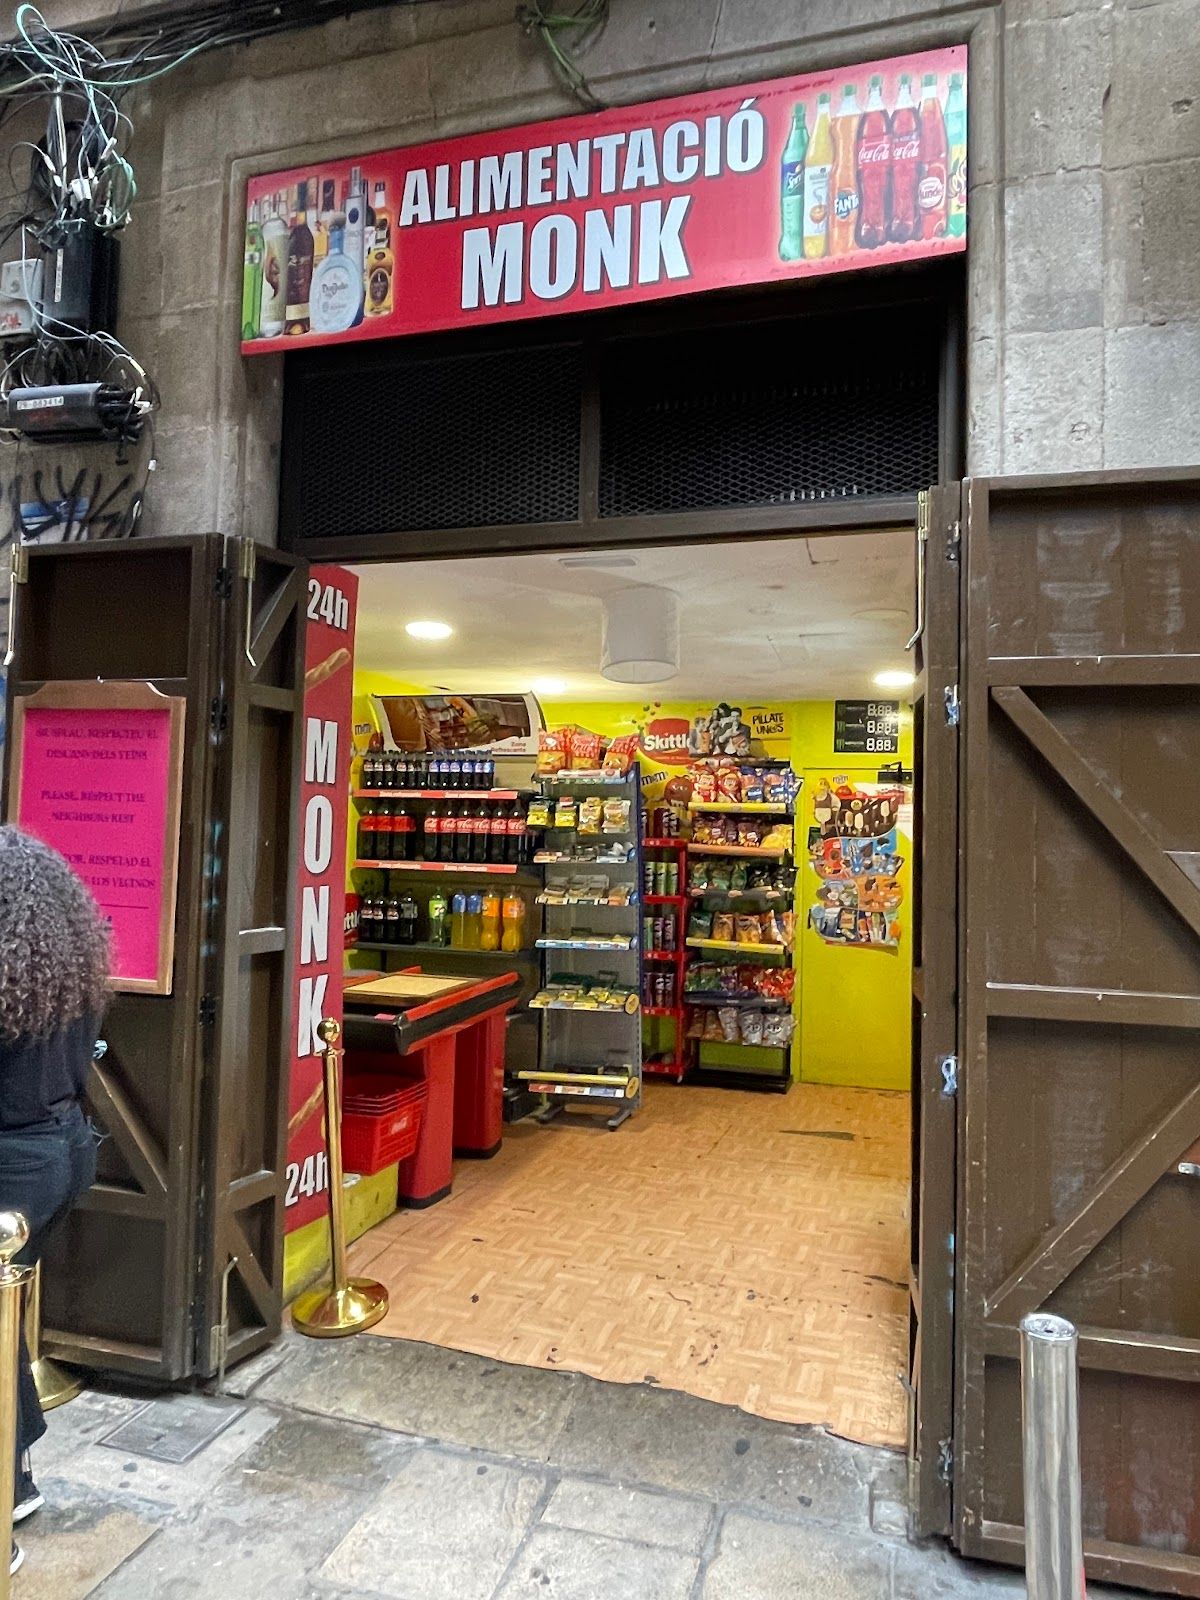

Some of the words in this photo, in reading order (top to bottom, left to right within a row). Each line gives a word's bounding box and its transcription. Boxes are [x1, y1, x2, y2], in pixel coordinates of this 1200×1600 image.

[399, 97, 764, 227] ALIMENTACIÓ
[460, 195, 691, 310] MONK
[306, 578, 350, 631] 24h
[297, 716, 339, 1058] MONK
[284, 1150, 329, 1208] 24h
